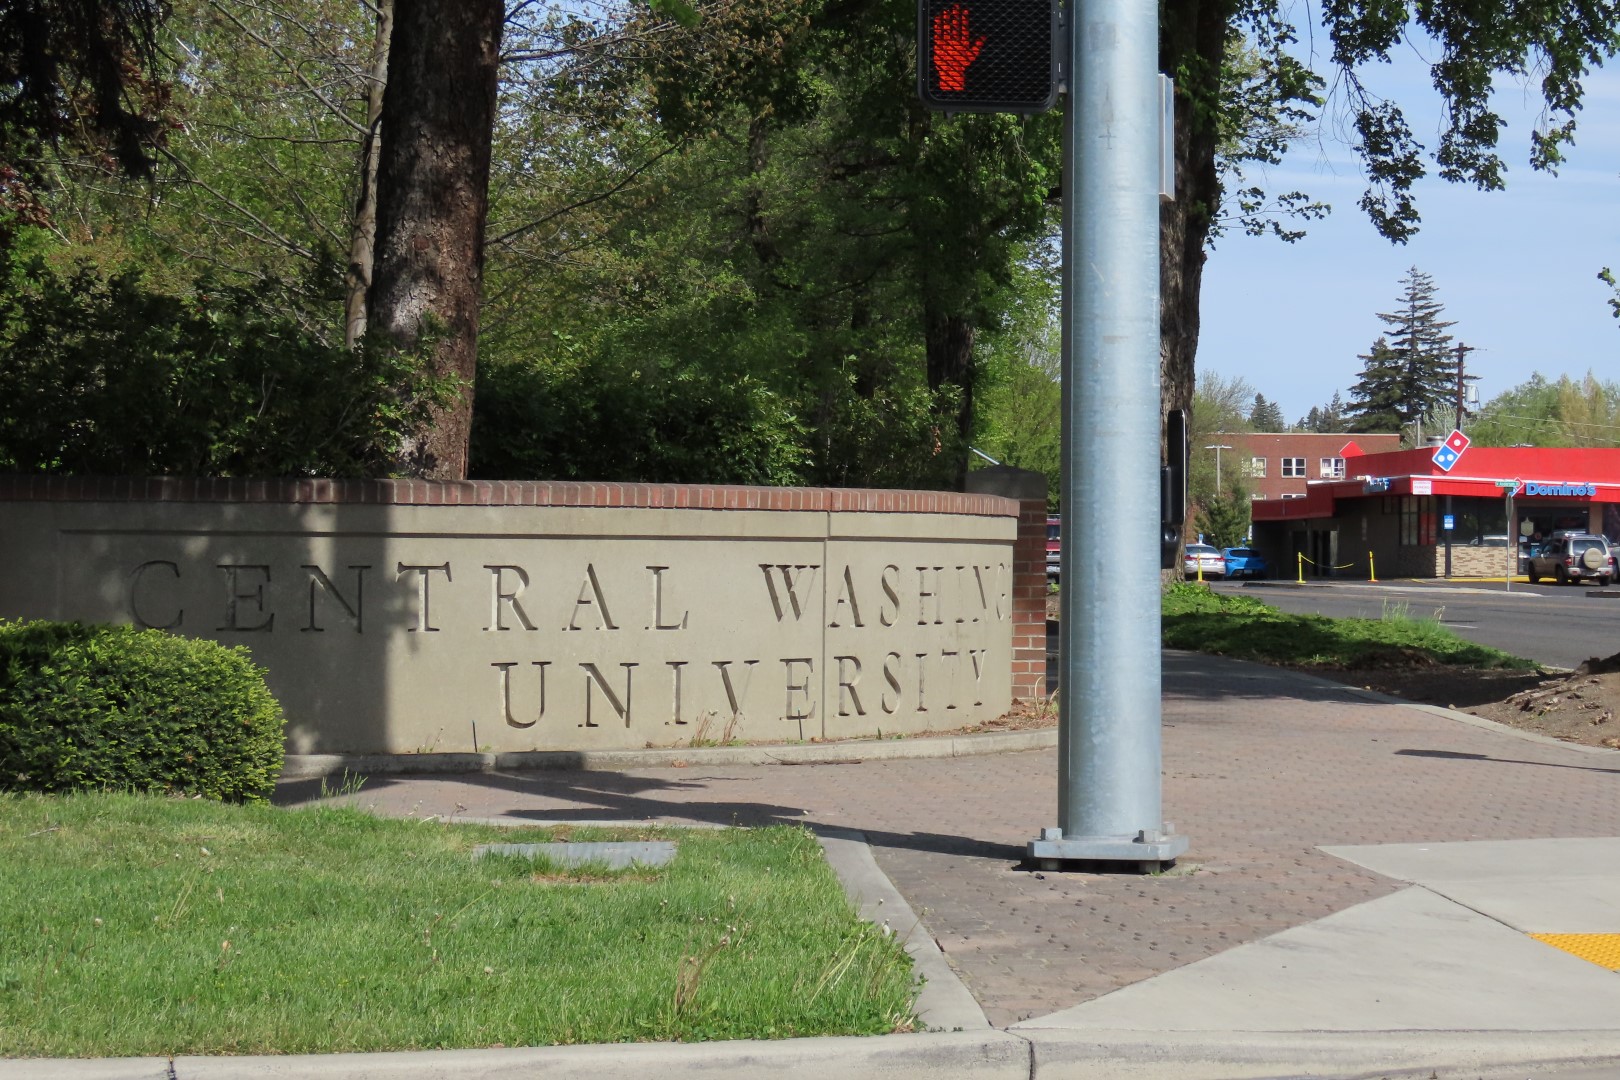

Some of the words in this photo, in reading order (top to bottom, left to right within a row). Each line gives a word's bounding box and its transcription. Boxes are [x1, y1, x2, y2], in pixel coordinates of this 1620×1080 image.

[1526, 482, 1596, 496] Domino's
[129, 560, 688, 633] CENTRAL
[758, 562, 1011, 629] WASHING
[491, 648, 986, 729] UNIVERSITY
